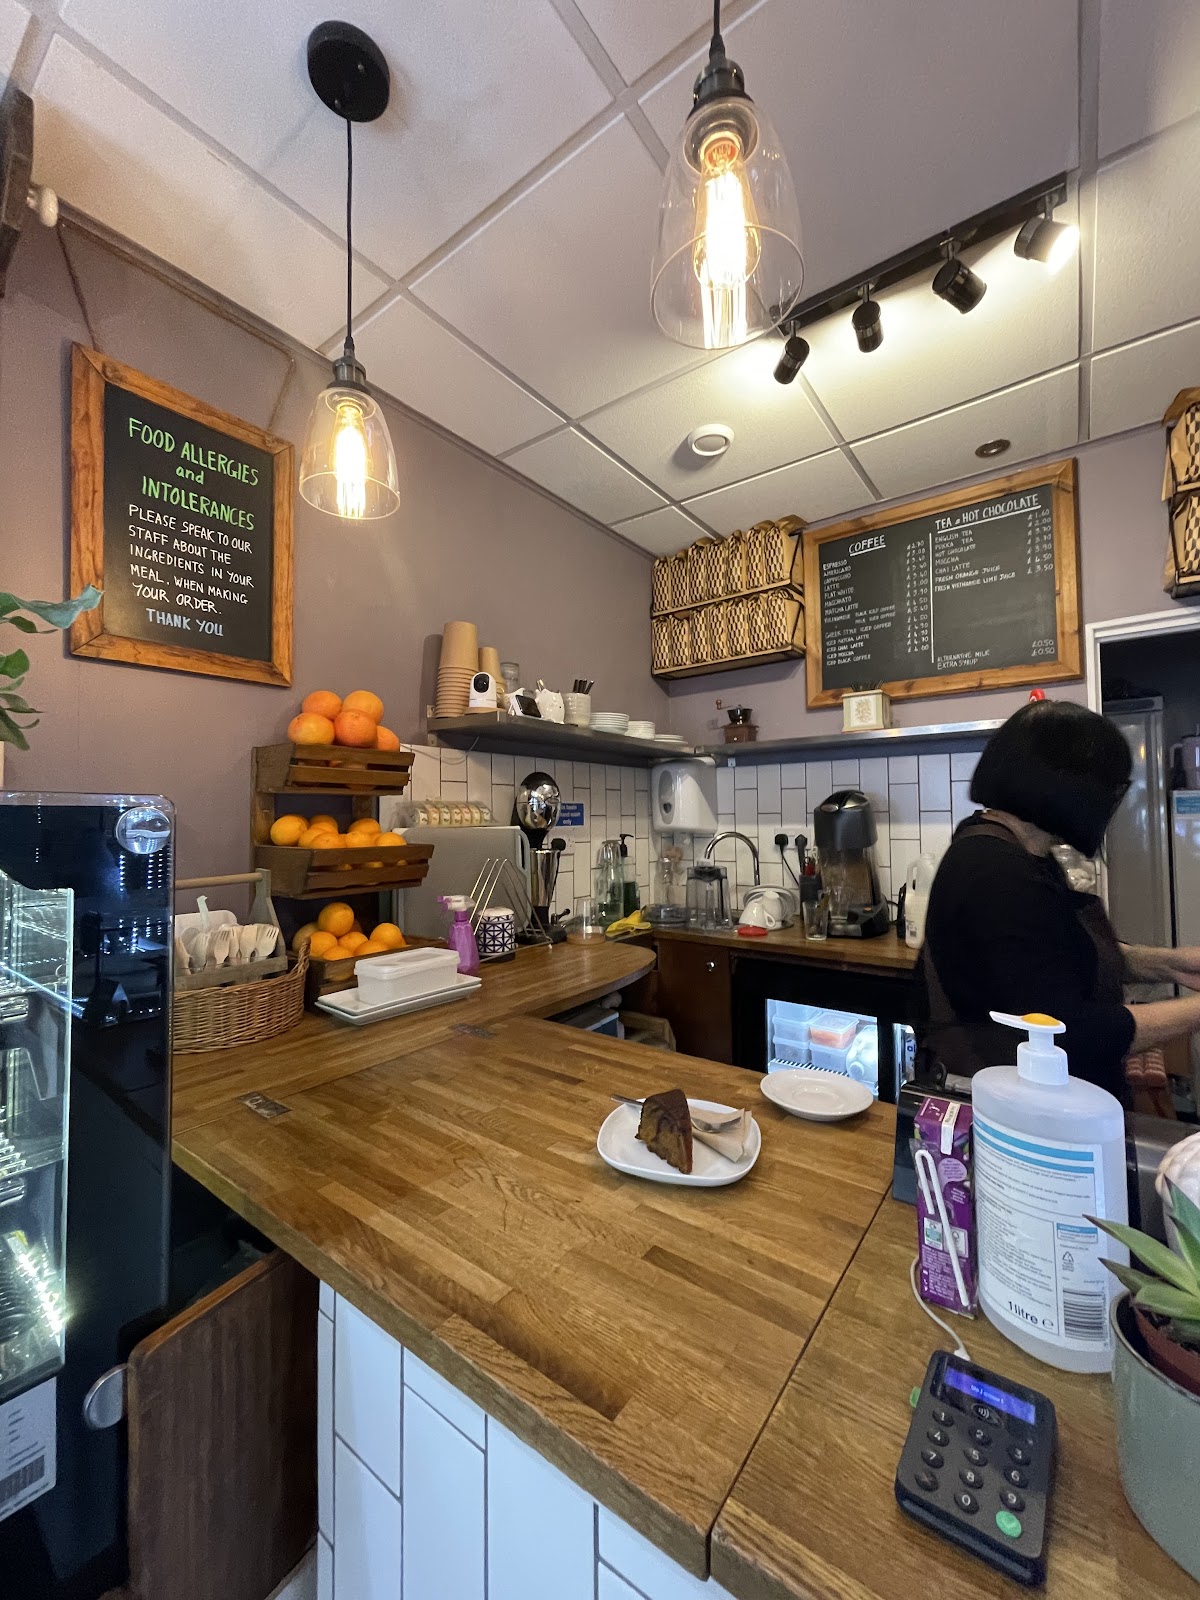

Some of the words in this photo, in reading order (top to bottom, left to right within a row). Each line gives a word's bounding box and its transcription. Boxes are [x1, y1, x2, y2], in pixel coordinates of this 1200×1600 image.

[128, 418, 176, 453] FOOD
[180, 442, 259, 486] ALLERGIES
[176, 466, 204, 485] and
[142, 476, 255, 530] INTOLERANCES
[935, 517, 952, 530] TEA
[962, 510, 980, 523] HOT
[982, 494, 1038, 518] CHOCOLATE
[129, 504, 176, 529] PLEASE
[181, 521, 215, 543] SPEAK
[217, 532, 229, 547] TO
[231, 538, 253, 554] OUR
[935, 532, 959, 543] ENGLISH
[128, 525, 168, 546] STAFF
[173, 538, 208, 558] ABOUT
[210, 550, 231, 565] THE
[848, 534, 885, 554] COFFEE
[935, 542, 954, 550] PUKKA
[948, 544, 976, 554] CHOCOLATE
[130, 544, 204, 575] INGREDIENTS
[211, 566, 223, 578] IN
[226, 570, 254, 588] YOUR
[823, 560, 847, 570] ESPRESSO
[823, 566, 851, 576] AMERICANO
[935, 566, 950, 574] CHAI
[952, 562, 970, 571] LATTE
[935, 575, 953, 583] FRESH
[955, 570, 979, 579] ORANGE
[982, 565, 1000, 574] JUICE
[824, 583, 840, 592] LATTE
[935, 584, 950, 592] FRESH
[983, 574, 997, 584] LIME
[1000, 572, 1016, 580] JUICE
[174, 578, 204, 594] WHEN
[208, 586, 248, 604] MAKING
[824, 591, 836, 599] FLAT
[838, 586, 854, 596] WHITE
[132, 582, 170, 603] YOUR
[176, 594, 222, 614] ORDER.
[825, 607, 844, 615] MATCHA
[845, 602, 858, 611] LATTE
[146, 608, 191, 631] THANK
[196, 618, 224, 637] YOU
[938, 652, 972, 662] ALTERNATIVE
[975, 649, 990, 657] MILK
[1032, 639, 1054, 648] £0.50
[938, 661, 958, 670] EXTRA
[959, 658, 978, 667] SYRUP
[1031, 647, 1055, 656] £0.50
[940, 1412, 945, 1421] 1
[934, 1432, 941, 1441] 4
[976, 1429, 984, 1437] 2
[929, 1451, 936, 1460] 7
[972, 1451, 980, 1460] 5
[1015, 1450, 1022, 1459] 3
[967, 1472, 975, 1482] 8
[1011, 1470, 1020, 1481] 6
[962, 1494, 970, 1506] 0
[1008, 1493, 1017, 1503] 9
